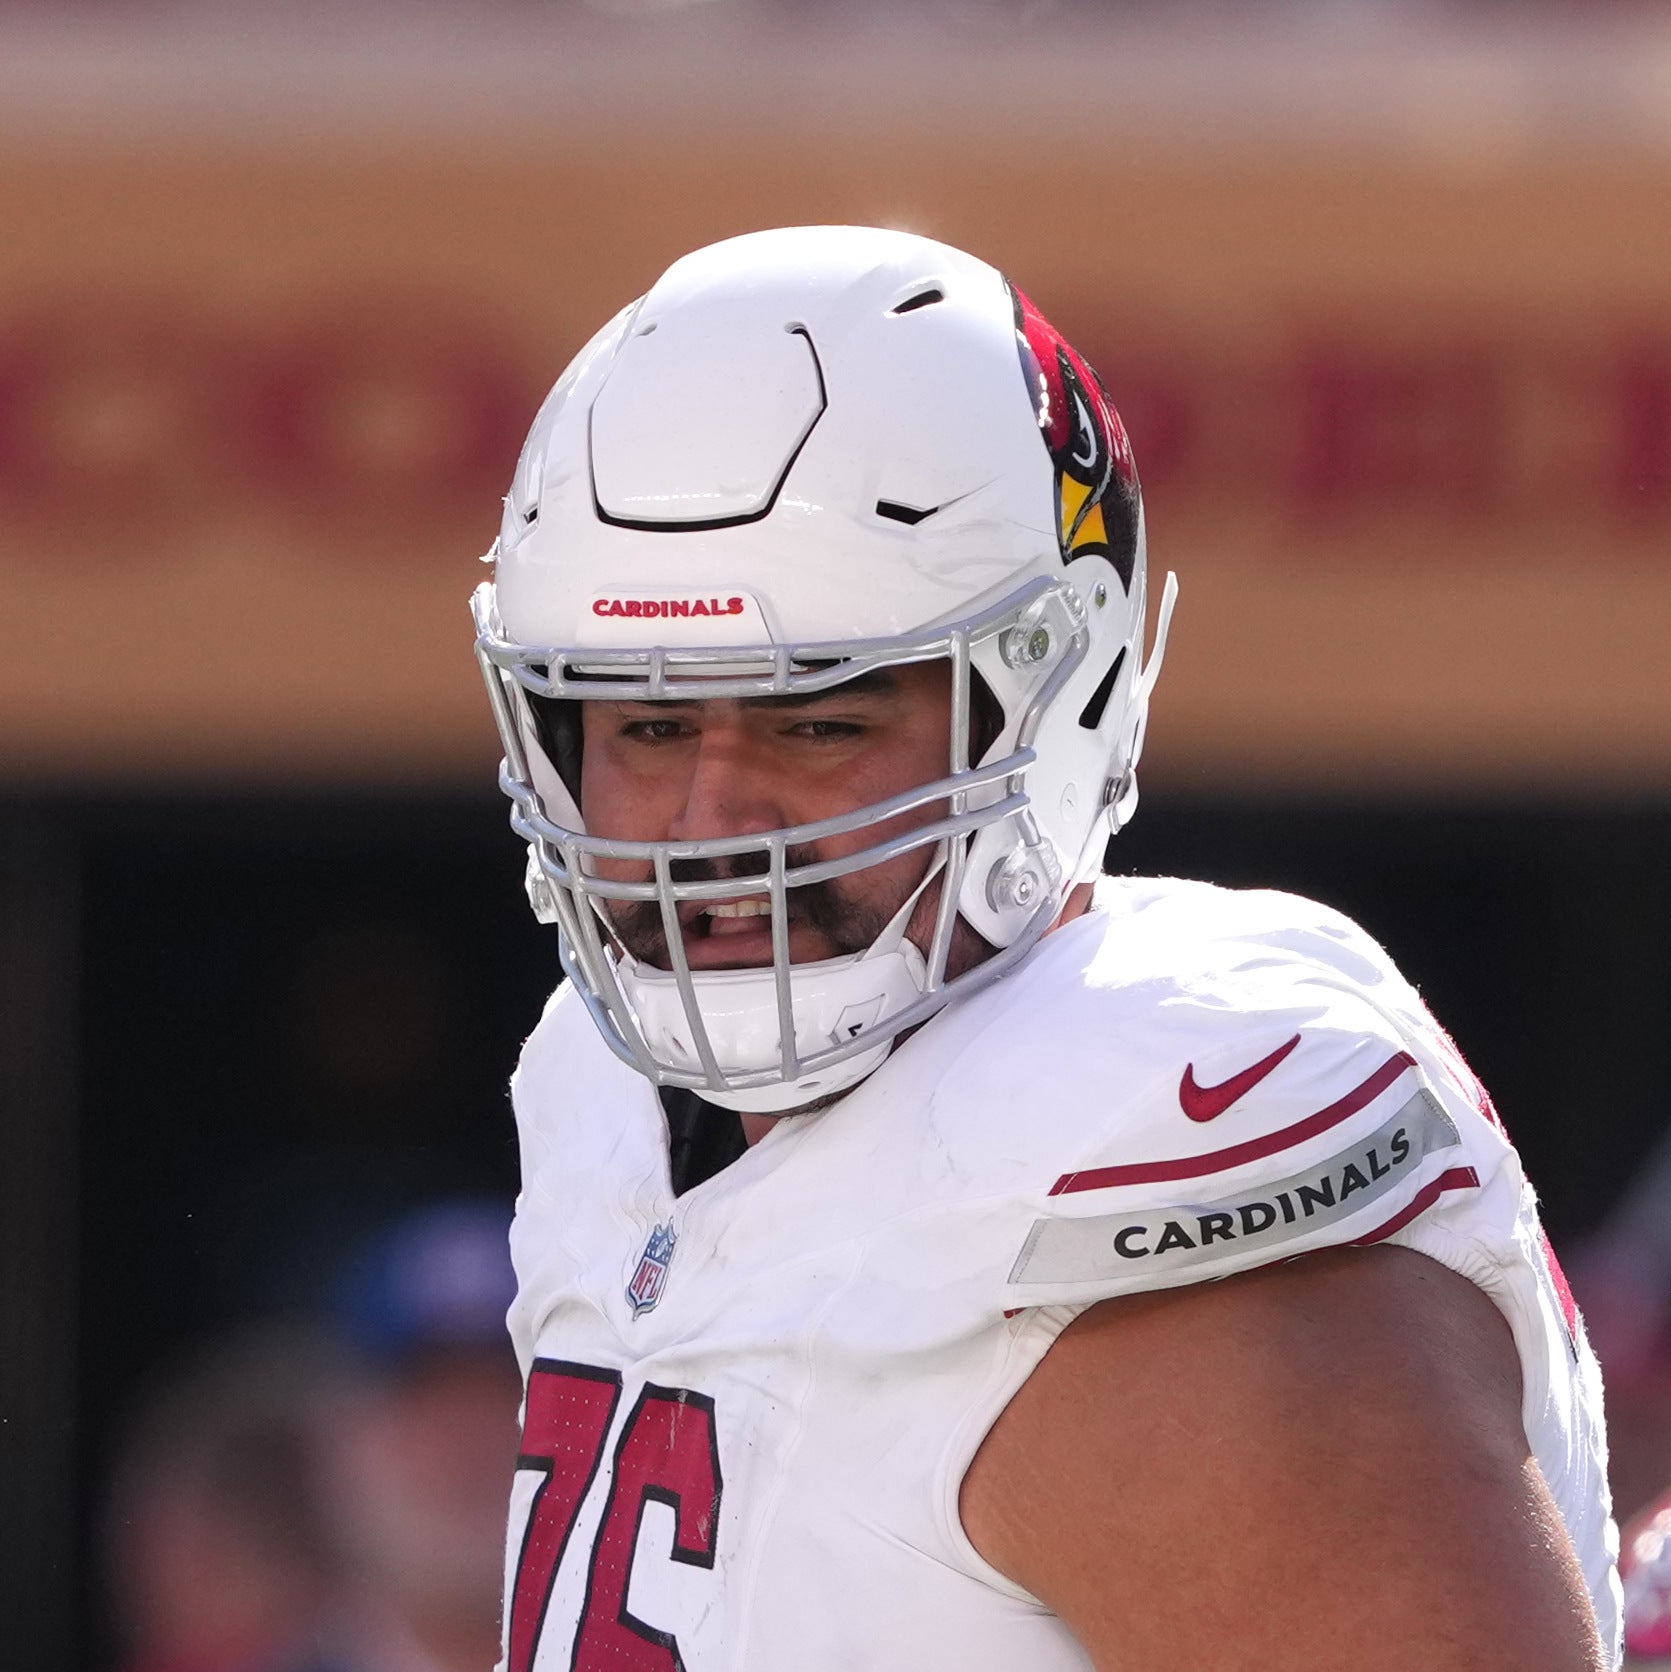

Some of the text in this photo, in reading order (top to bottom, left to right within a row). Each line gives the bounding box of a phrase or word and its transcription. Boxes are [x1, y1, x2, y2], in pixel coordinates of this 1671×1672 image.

[591, 596, 745, 619] CARDINALS
[1113, 1127, 1411, 1260] CARDINALS
[631, 1259, 664, 1302] NFL
